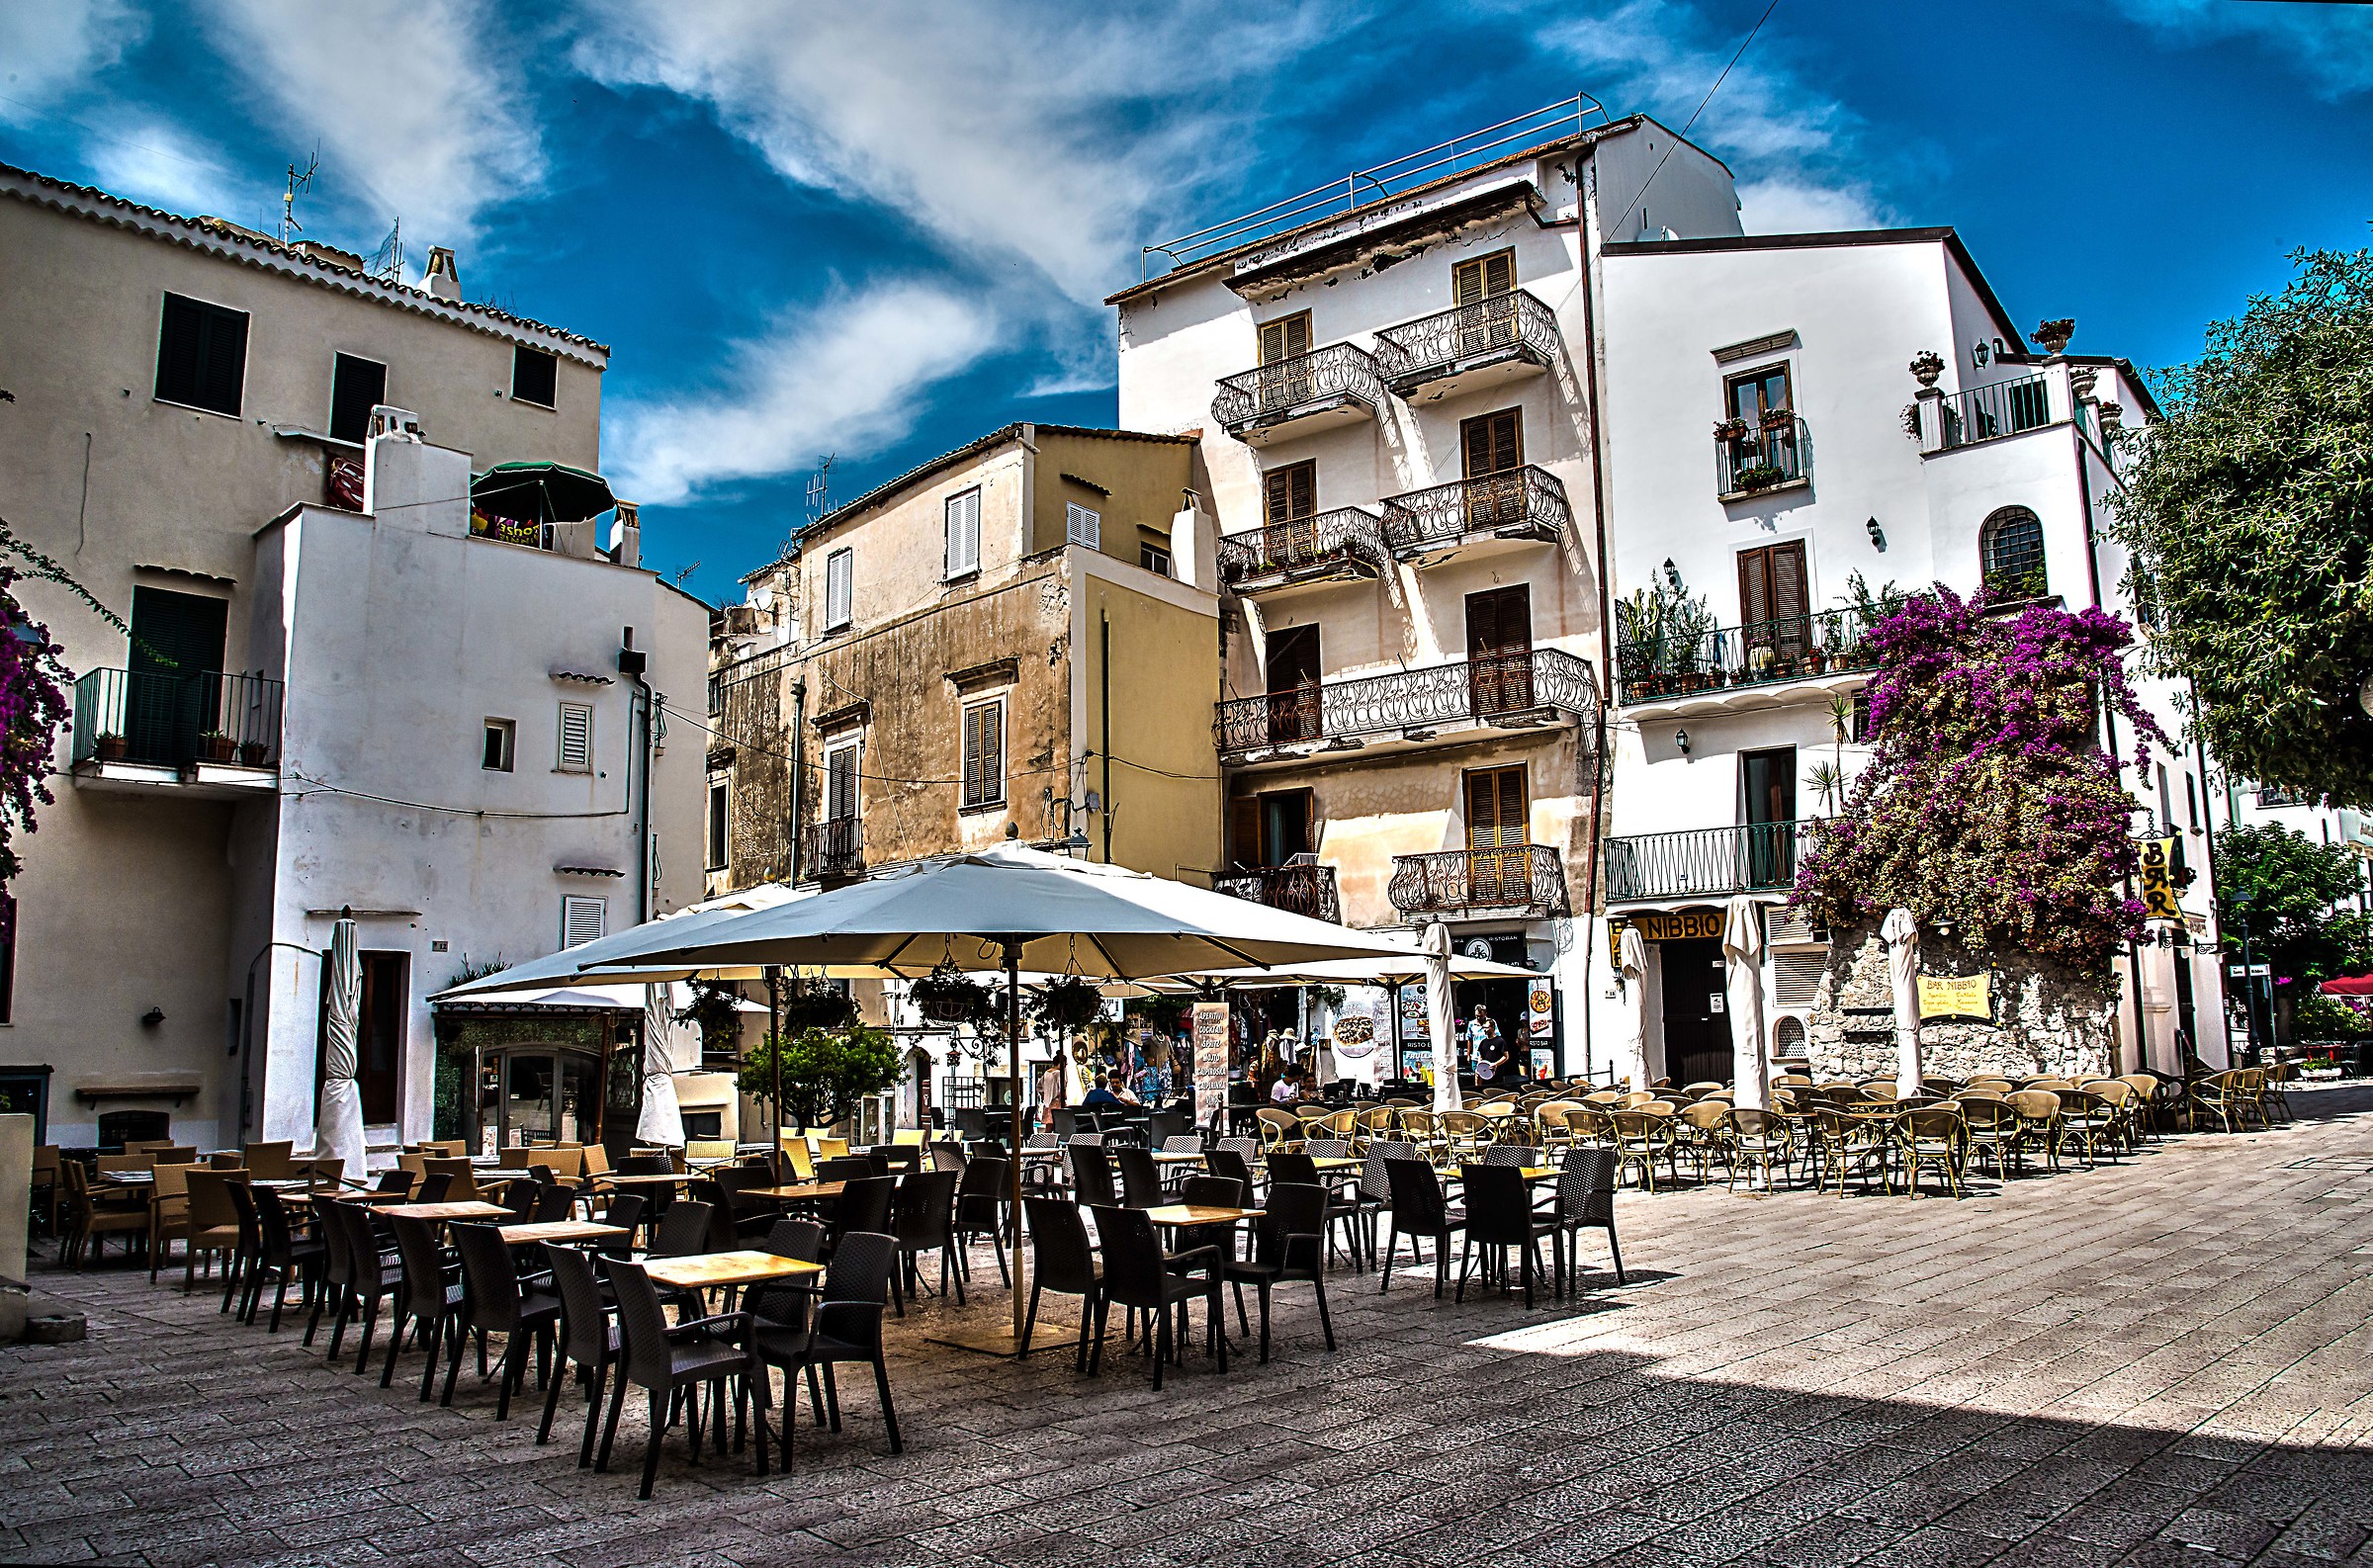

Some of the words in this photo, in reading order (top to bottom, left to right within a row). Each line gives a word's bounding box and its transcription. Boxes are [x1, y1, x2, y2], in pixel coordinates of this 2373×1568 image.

[2143, 841, 2177, 915] BAR
[1646, 915, 1720, 938] NIBBIO
[1927, 980, 1943, 990] BAR
[1947, 980, 1977, 990] NIBBIO
[1198, 1025, 1224, 1034] COCKTAIL
